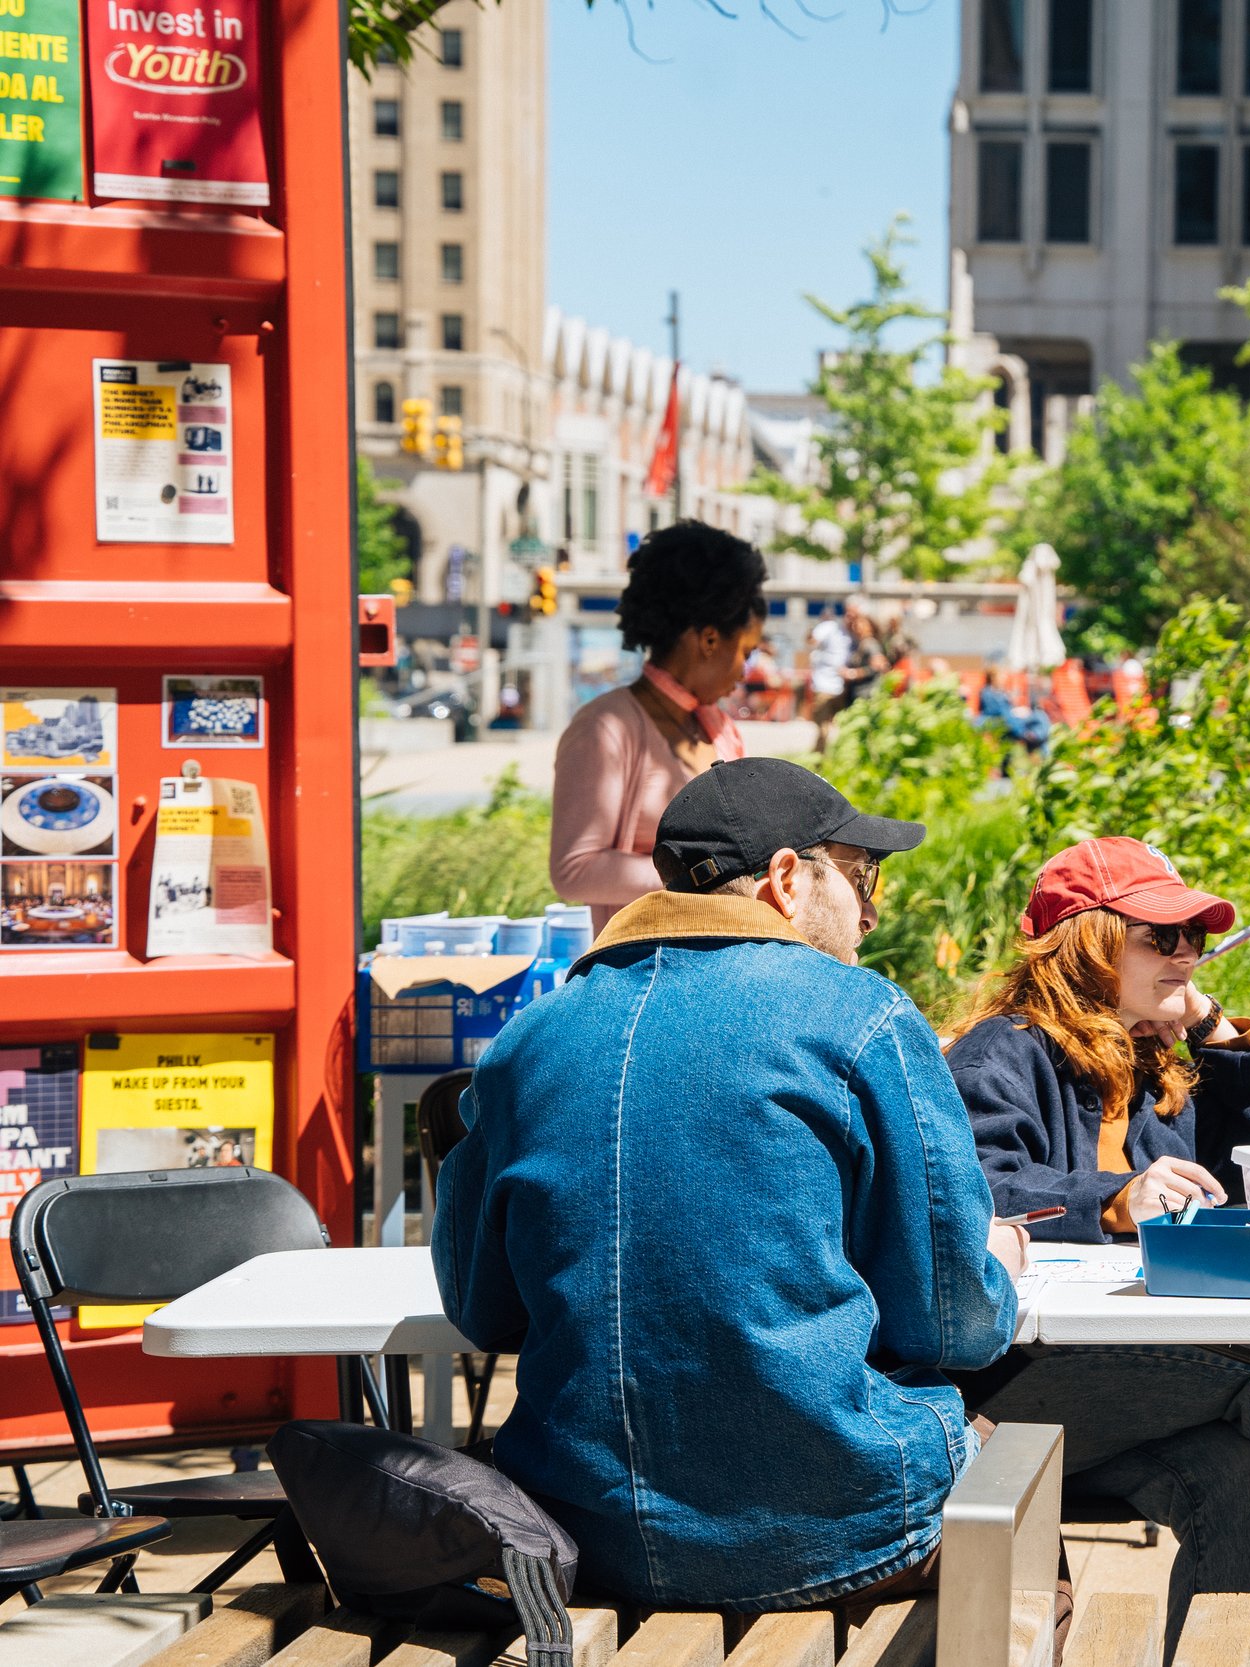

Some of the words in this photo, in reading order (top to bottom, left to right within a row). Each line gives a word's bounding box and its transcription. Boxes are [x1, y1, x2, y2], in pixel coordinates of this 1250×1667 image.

[108, 0, 206, 38] Invest
[214, 9, 243, 40] in
[127, 42, 231, 84] Youth
[31, 74, 64, 103] AL
[0, 113, 45, 142] LER
[112, 1076, 149, 1089] WAKE
[152, 1077, 169, 1089] UP
[173, 1077, 208, 1089] FROM
[212, 1076, 246, 1089] YOUR
[154, 1098, 202, 1111] SIESTA.
